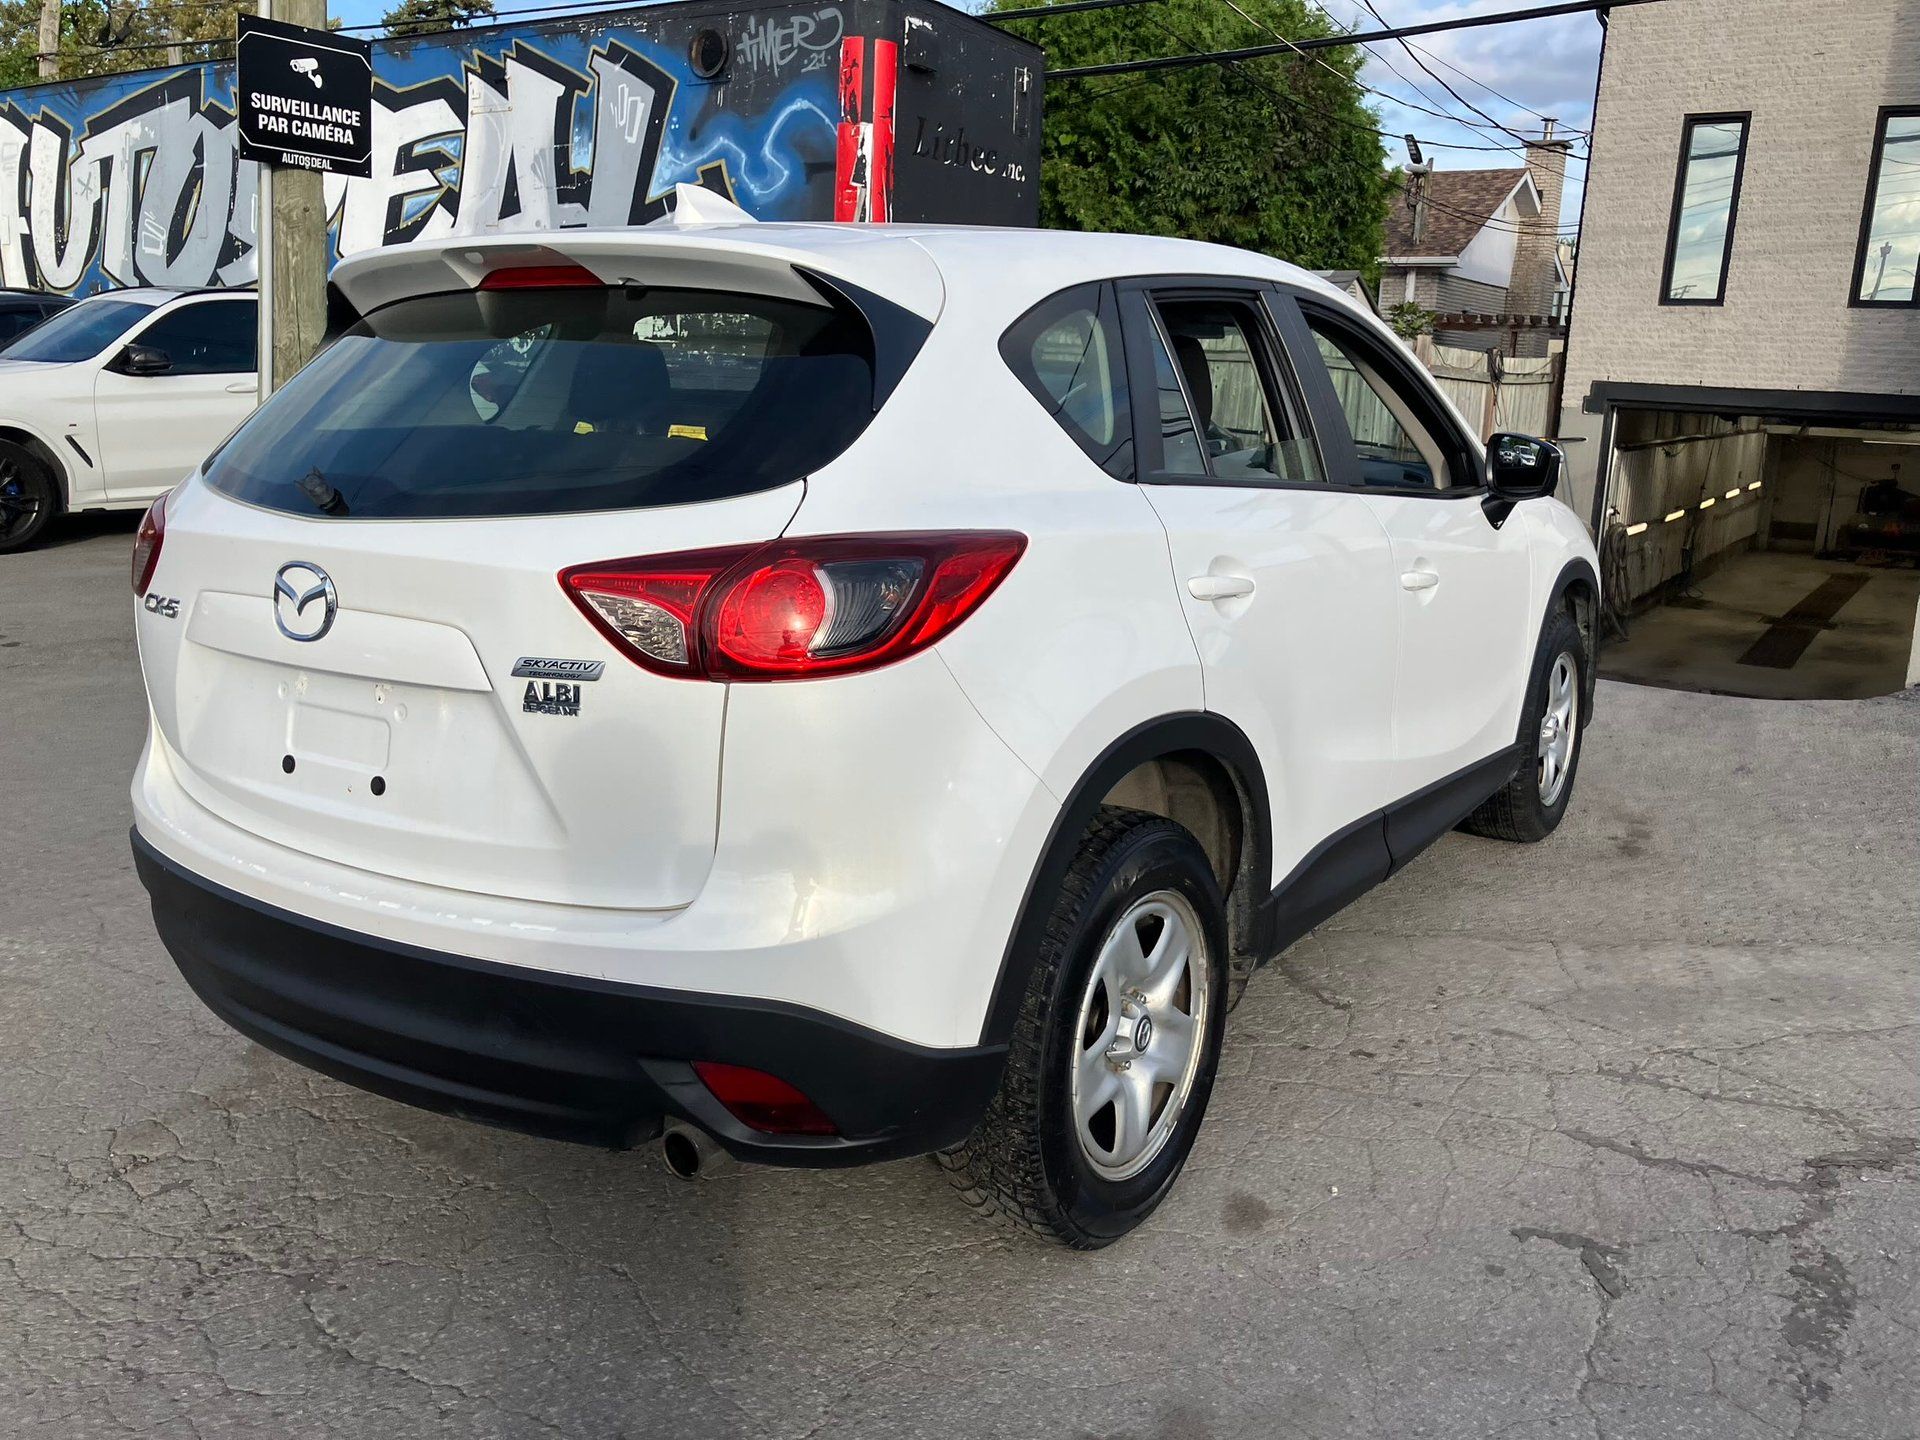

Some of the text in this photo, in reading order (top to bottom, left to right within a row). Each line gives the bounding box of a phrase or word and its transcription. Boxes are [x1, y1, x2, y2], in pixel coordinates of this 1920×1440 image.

[250, 92, 361, 127] SURVEILLANCE
[258, 113, 355, 145] PAR CAMÉRA
[144, 592, 181, 619] CX-5
[521, 659, 595, 671] SKYACTIV
[528, 671, 581, 679] TECHNOLOGY
[523, 680, 581, 704] ALBI
